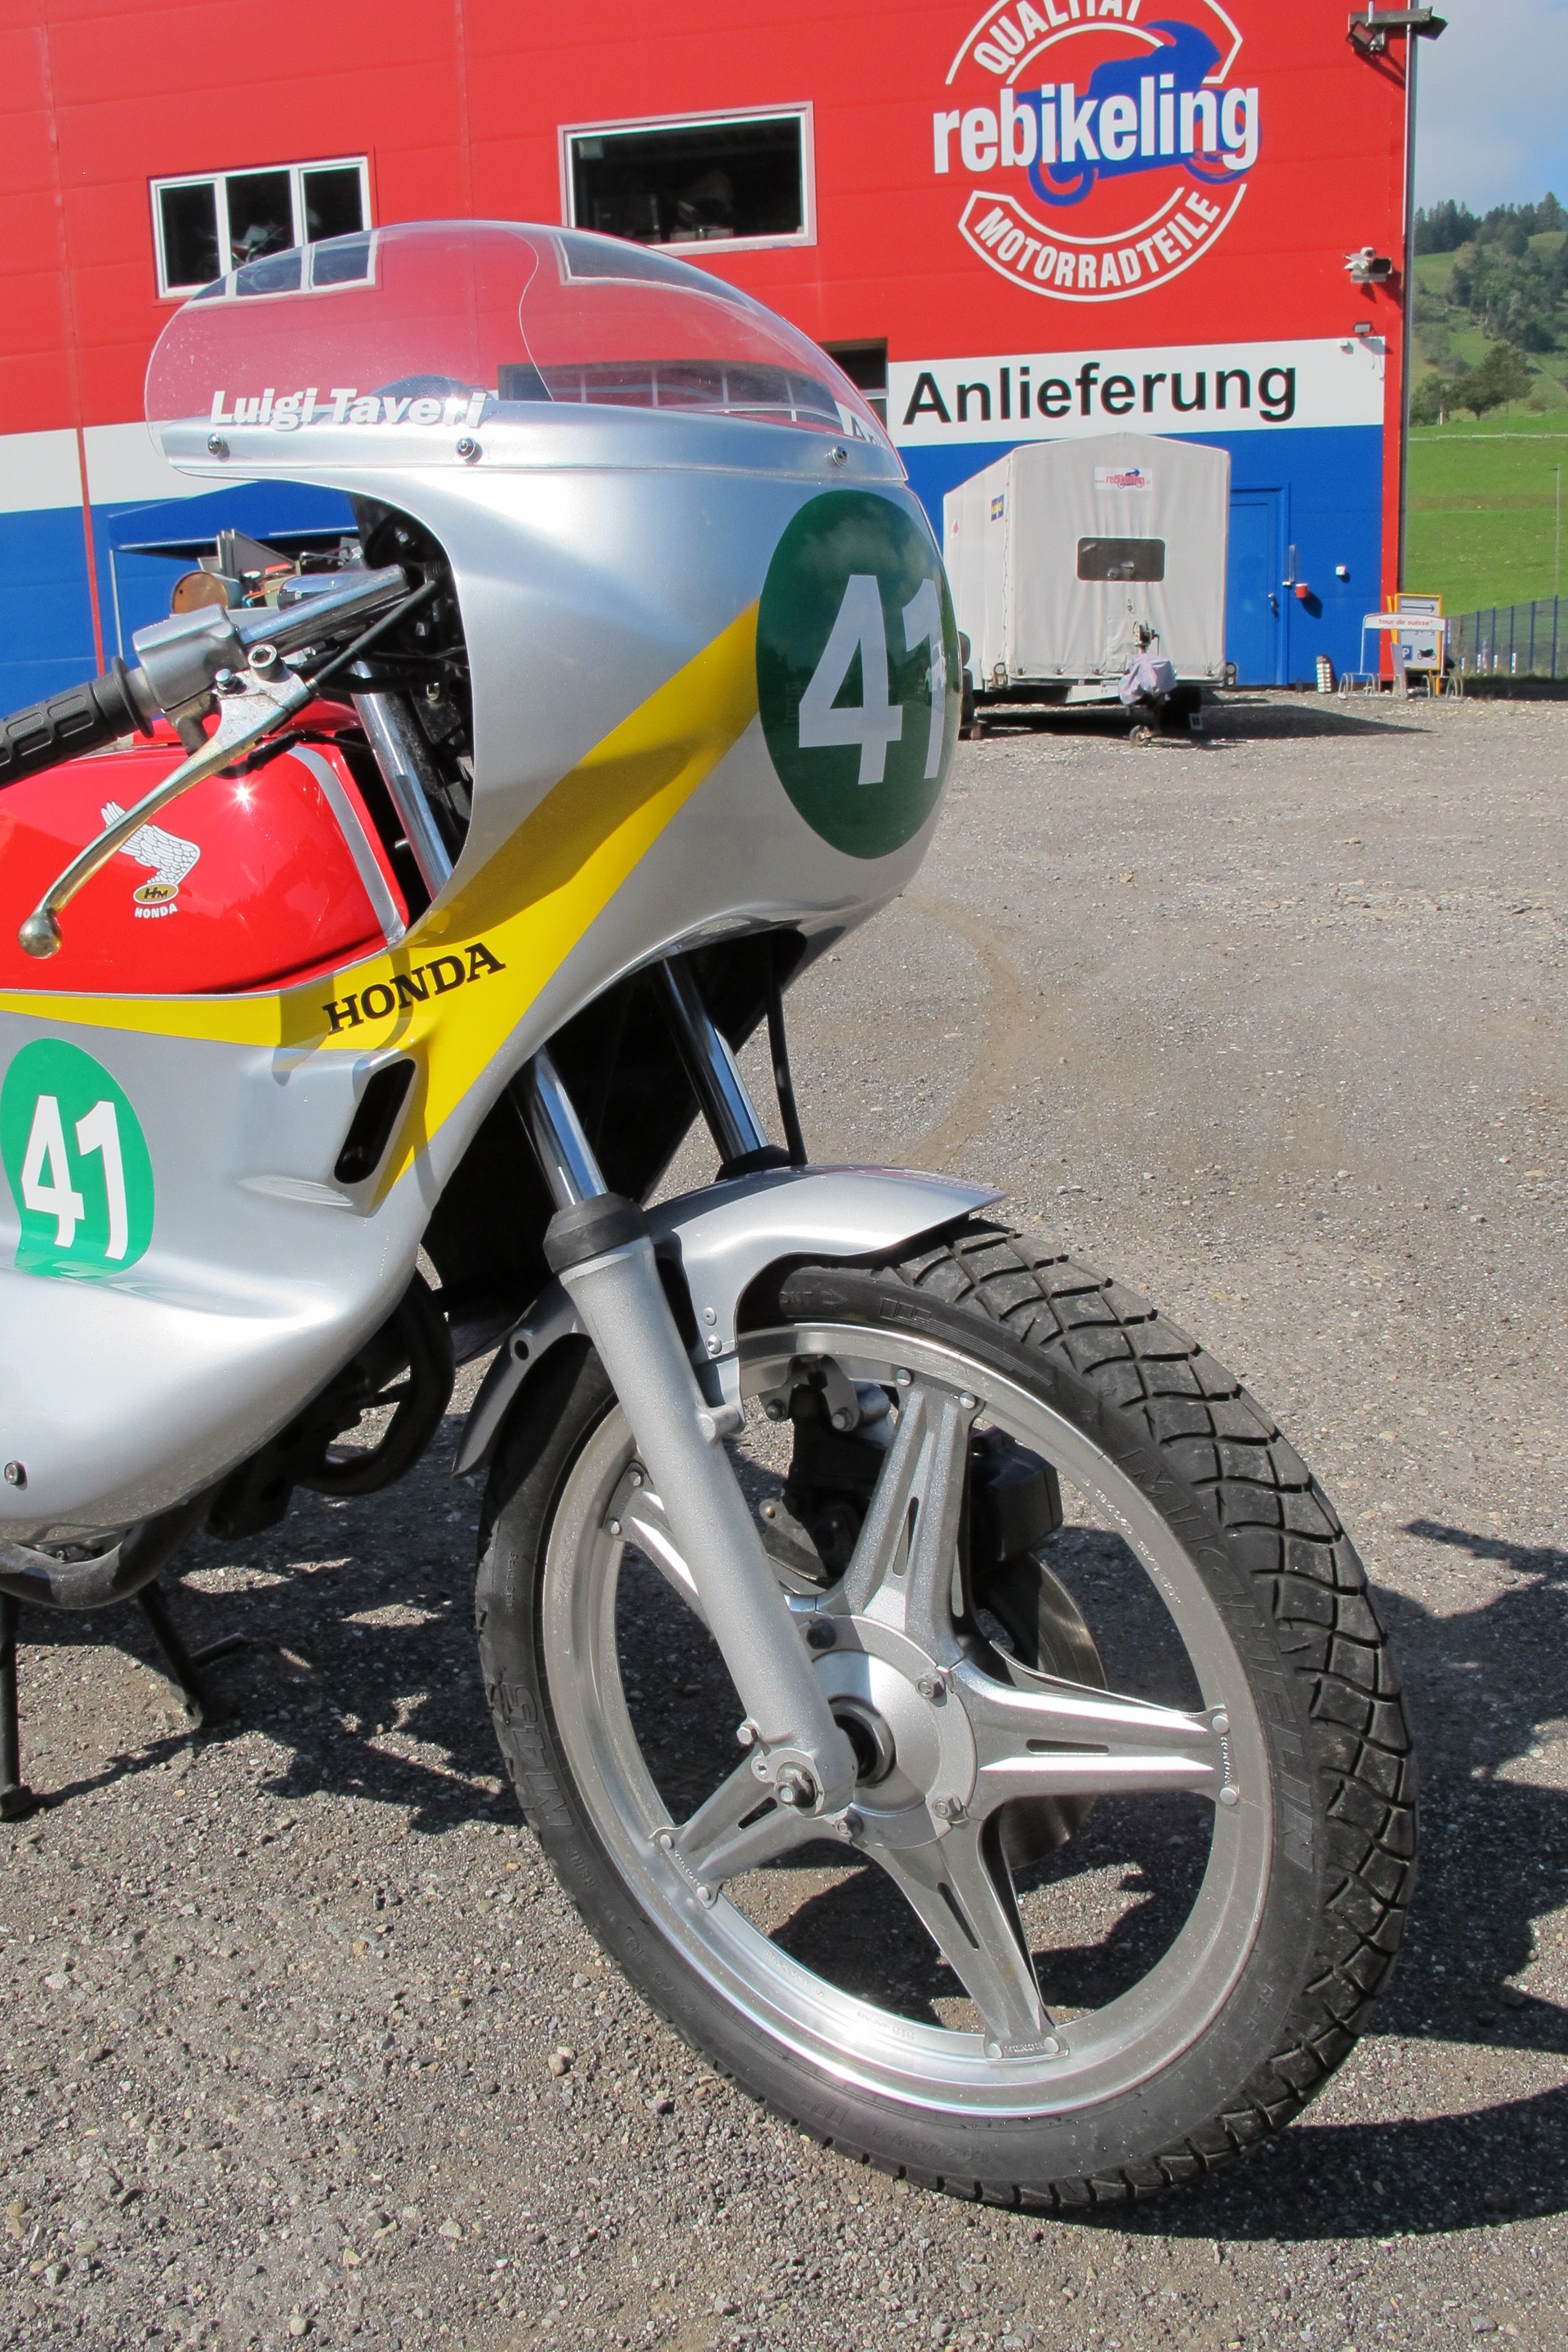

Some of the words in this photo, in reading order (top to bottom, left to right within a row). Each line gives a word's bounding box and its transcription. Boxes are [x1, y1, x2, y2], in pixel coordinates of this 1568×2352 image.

[933, 73, 1258, 174] rebikeling
[974, 191, 1220, 288] MOTORRADTEILE
[210, 388, 318, 431] Luigi
[330, 388, 487, 428] Taveri
[902, 362, 1296, 425] Anlieferung
[799, 574, 946, 786] 41
[134, 902, 178, 919] HONDA
[323, 942, 506, 1036] HONDA
[21, 1094, 129, 1261] 41
[1117, 1448, 1315, 1873] MICHELIN
[501, 1681, 575, 1827] M45
